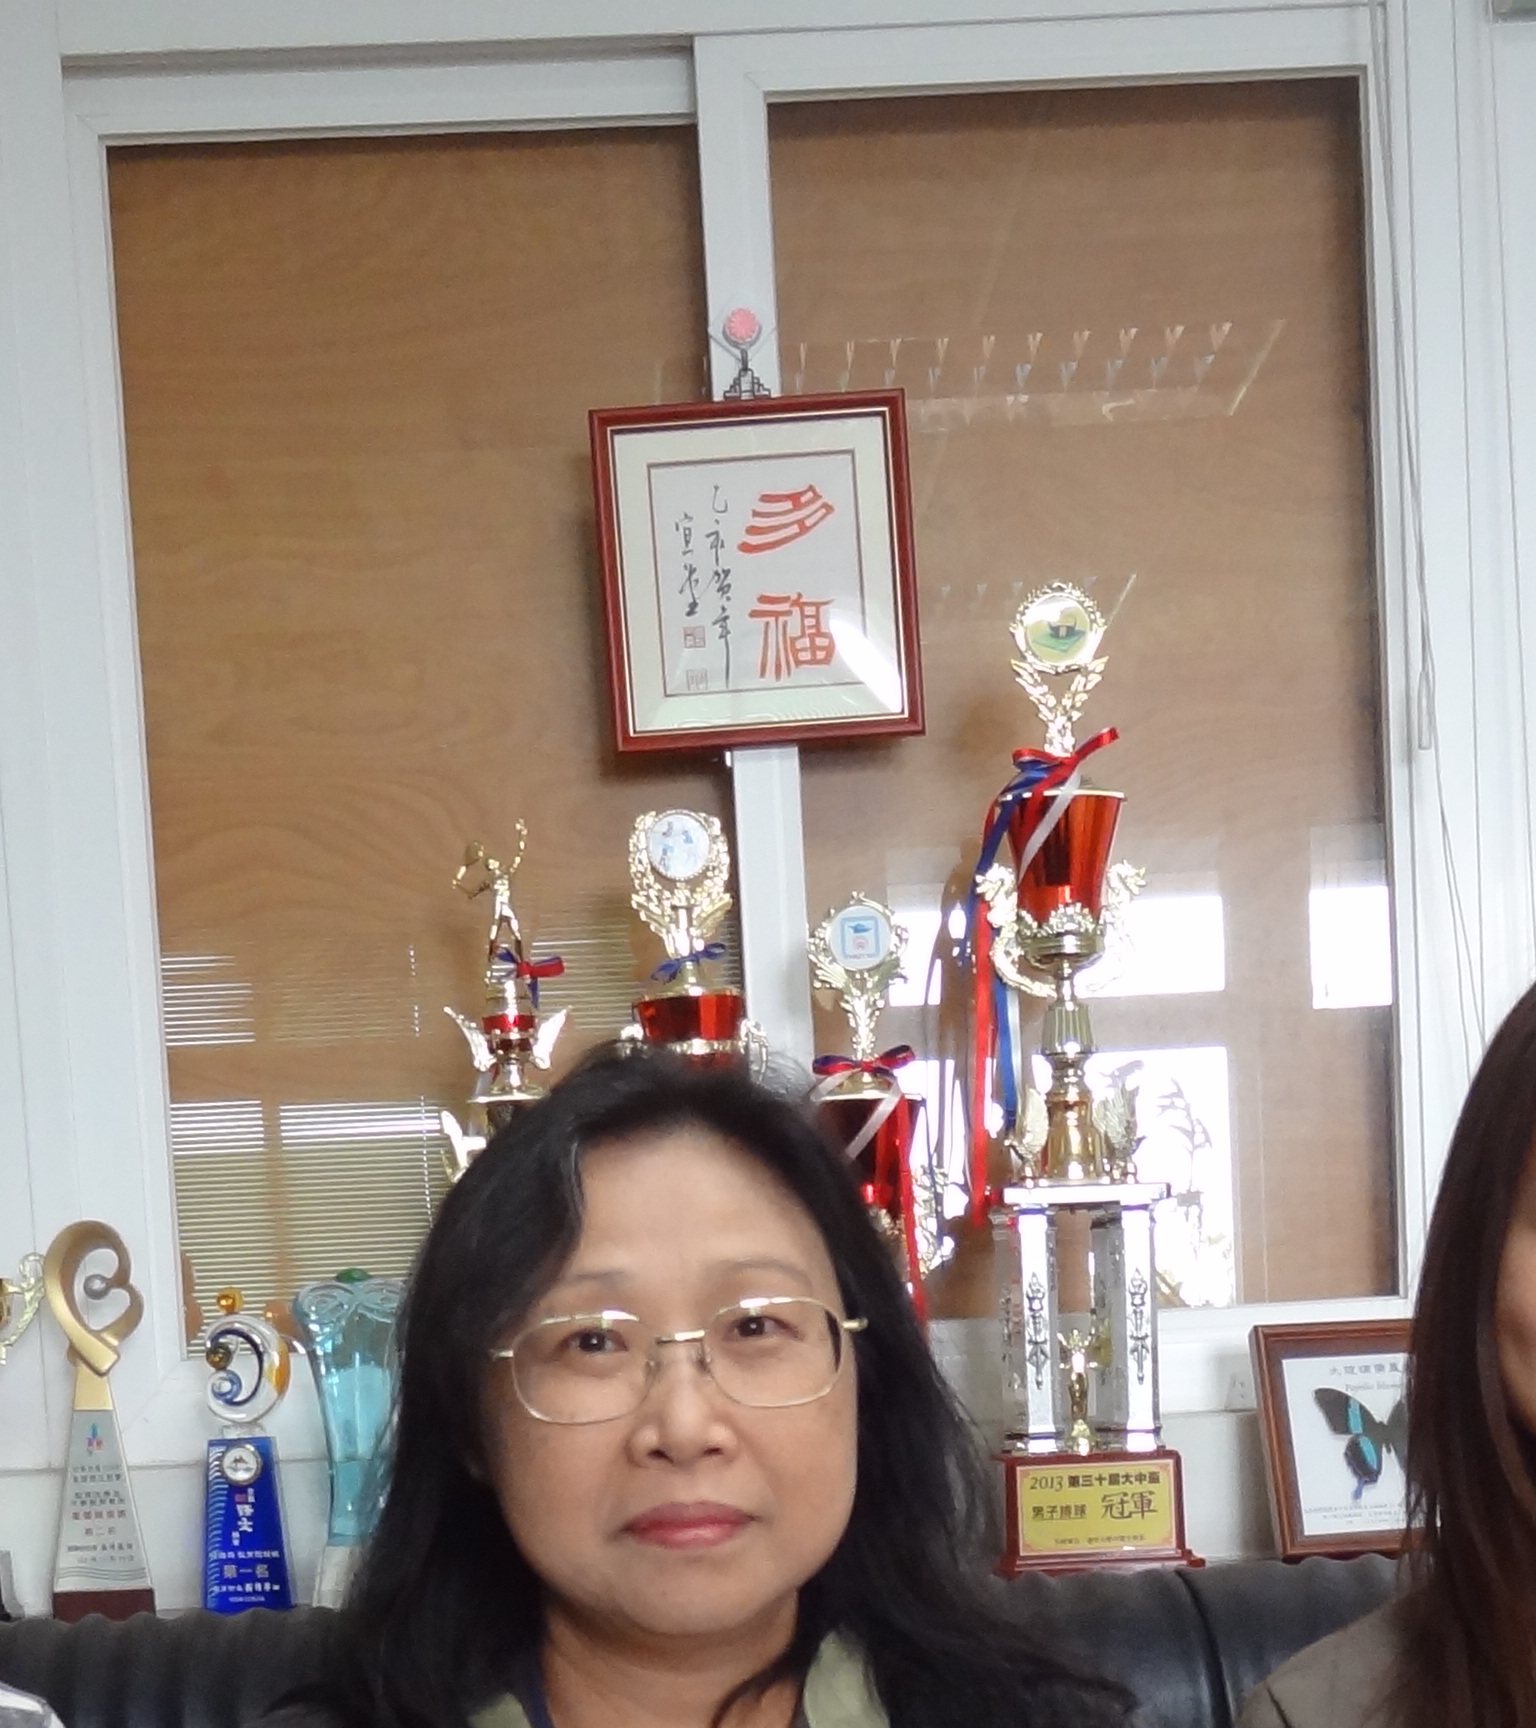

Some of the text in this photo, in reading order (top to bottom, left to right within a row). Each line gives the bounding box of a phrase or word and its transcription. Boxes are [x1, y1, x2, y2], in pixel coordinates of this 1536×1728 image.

[737, 483, 836, 681] 多福
[1029, 1471, 1161, 1492] 2013 第三十屆大中盃
[1032, 1490, 1158, 1521] 男子排球 冠軍
